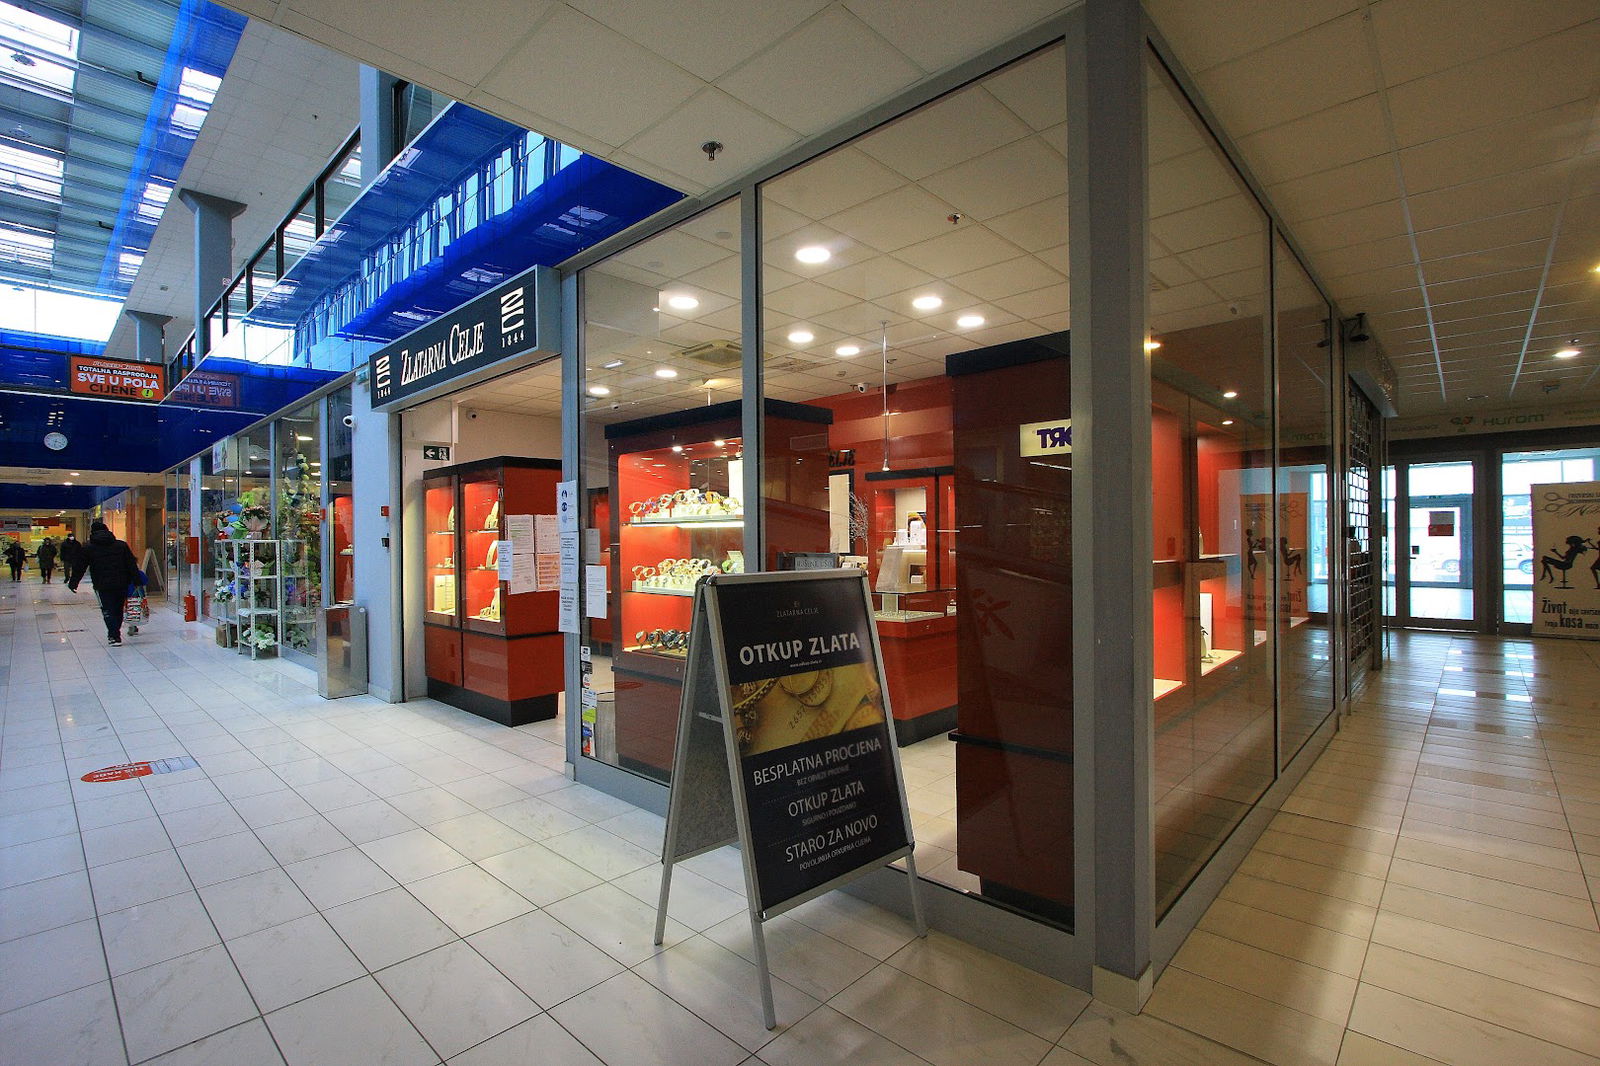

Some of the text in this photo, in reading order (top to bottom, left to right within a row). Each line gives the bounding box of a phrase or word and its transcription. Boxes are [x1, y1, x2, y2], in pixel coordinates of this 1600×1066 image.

[78, 365, 112, 374] TOTALNA
[113, 369, 158, 380] RASPRODAJA
[77, 373, 159, 390] SVE U POLA
[89, 383, 137, 396] CIJENE
[1542, 597, 1567, 614] Život
[1560, 614, 1583, 629] kosa
[739, 632, 861, 666] OTKUP ZLATA
[753, 737, 882, 786] BESPLATNA PROCJENA
[788, 780, 865, 817] OTKUP ZLATA
[785, 814, 878, 862] STARO ZA NOVO
